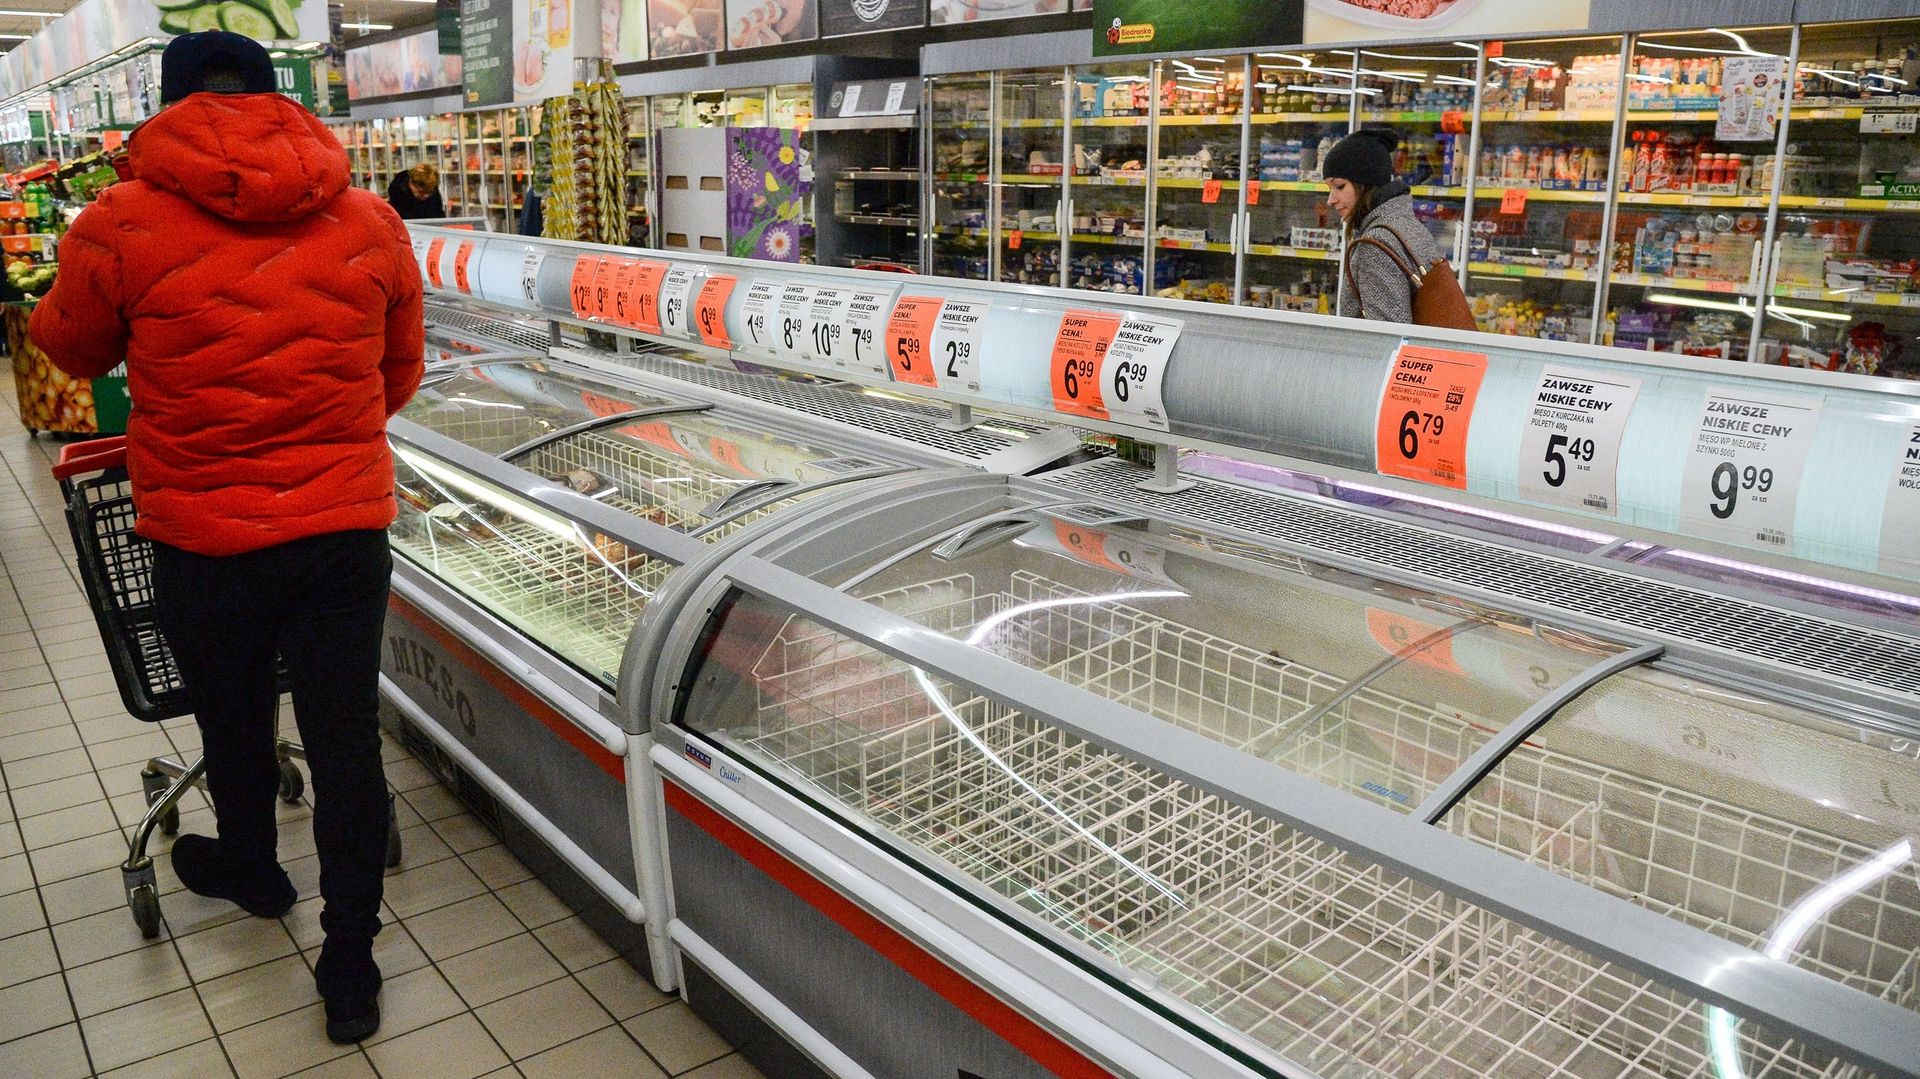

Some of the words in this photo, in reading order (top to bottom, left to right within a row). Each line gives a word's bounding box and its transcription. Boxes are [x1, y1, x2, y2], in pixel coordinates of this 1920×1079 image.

[1121, 28, 1152, 36] Biedronka
[945, 304, 971, 312] ZAWSZE
[942, 314, 963, 322] NISKIE
[1065, 319, 1087, 327] SUPER
[1123, 321, 1154, 332] ZAWSZE
[1062, 329, 1082, 338] CENA!
[1118, 332, 1144, 341] NISKIE
[1142, 336, 1164, 345] CENY
[1400, 360, 1433, 372] SUPER
[1395, 372, 1427, 384] CENA!
[1542, 379, 1594, 394] ZAWSZE
[1538, 392, 1577, 406] NISKIE
[1578, 398, 1612, 411] CENY
[1707, 401, 1768, 418] ZAWSZE
[1531, 418, 1555, 428] PULPETY
[1556, 411, 1584, 423] KURCZAKA
[1702, 416, 1750, 432] NISKIE
[1752, 423, 1792, 437] CENY
[1720, 436, 1731, 444] WP
[1732, 439, 1760, 450] MIELONE
[1696, 444, 1719, 455] SZYNKI
[1720, 448, 1736, 458] 500G
[720, 766, 741, 783] Chiller
